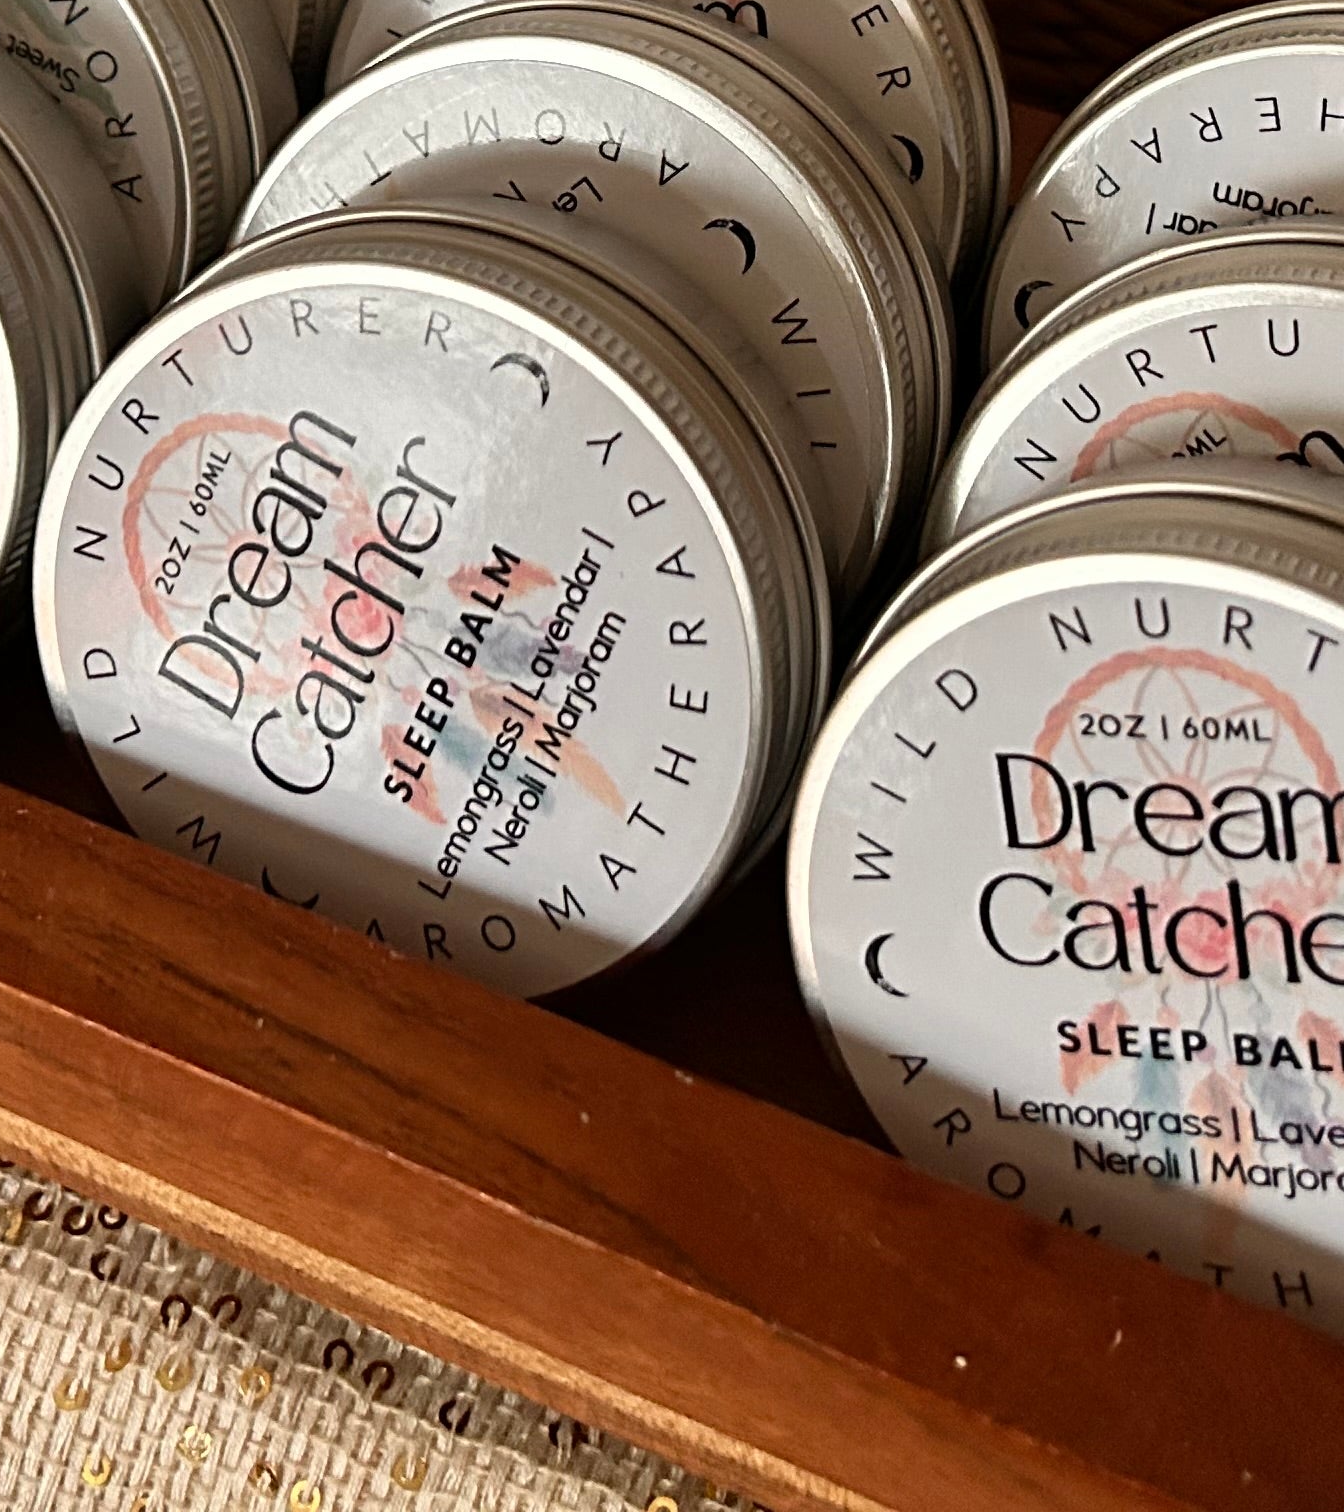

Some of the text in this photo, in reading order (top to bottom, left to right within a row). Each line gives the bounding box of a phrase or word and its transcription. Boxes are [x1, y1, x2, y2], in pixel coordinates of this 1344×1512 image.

[308, 106, 691, 212] AROMATH
[72, 294, 454, 865] WILD NURTURER
[156, 407, 359, 720] Dream
[189, 447, 234, 518] 60ML
[249, 432, 457, 796] Catcher
[383, 542, 523, 806] SLEEP BALM
[416, 716, 526, 901] Lemongrass
[528, 564, 601, 702] Lavendar
[484, 770, 546, 866] Neroli
[543, 609, 628, 764] Marjoram
[854, 667, 979, 884] WILD
[1181, 715, 1273, 744] 60ML
[991, 1089, 1222, 1142] Lemongrass
[1057, 1020, 1209, 1063] SLEEP
[1072, 1140, 1183, 1183] Neroli
